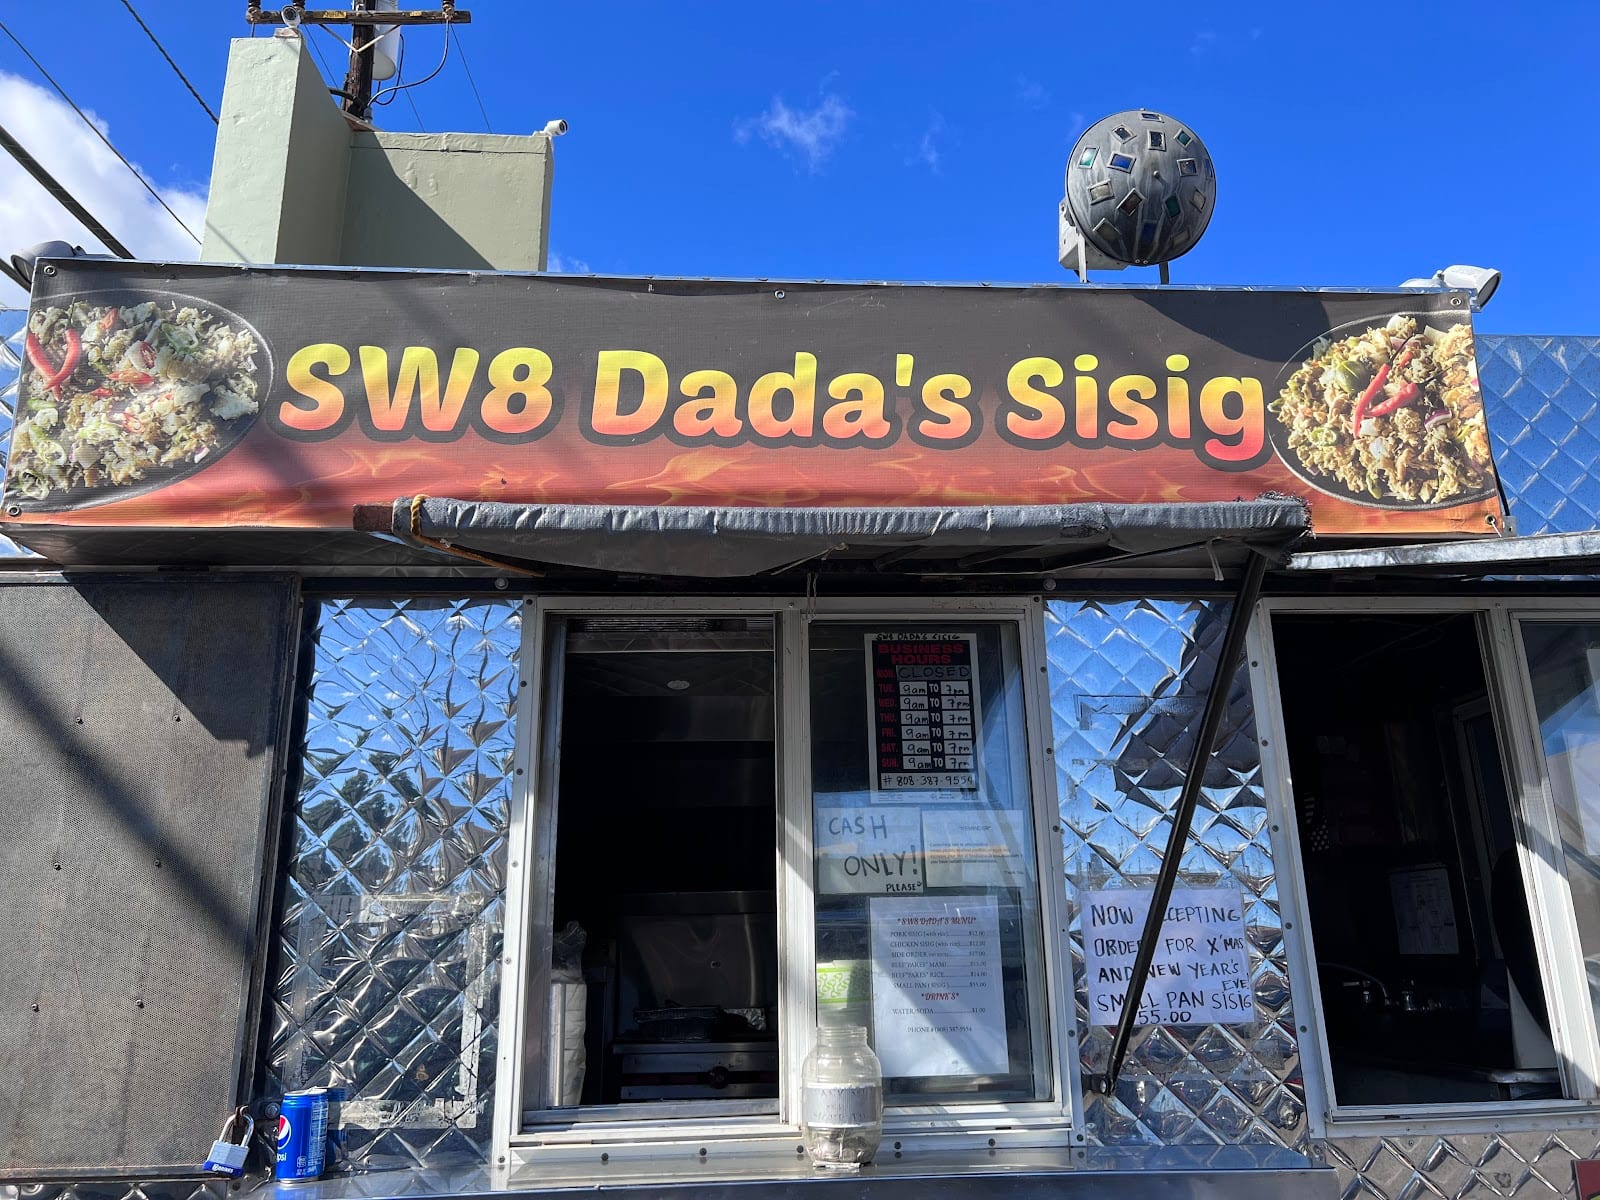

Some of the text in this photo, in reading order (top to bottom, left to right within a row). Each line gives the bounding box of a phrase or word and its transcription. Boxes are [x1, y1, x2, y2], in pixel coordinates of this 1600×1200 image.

[279, 343, 1265, 461] SW8 Dada's Sisig
[878, 644, 964, 654] BUSINESS
[891, 655, 952, 664] HOURS
[898, 667, 970, 679] CLOSED
[929, 683, 939, 692] TO
[930, 698, 940, 707] TO
[931, 713, 941, 722] TO
[932, 728, 942, 737] TO
[932, 743, 943, 752] TO
[933, 758, 943, 767] TO
[829, 815, 887, 839] CASH
[844, 844, 918, 876] ONLY!
[1091, 905, 1133, 927] NOW
[1165, 938, 1197, 955] FOR
[1207, 934, 1244, 956] X'MAS
[1187, 959, 1239, 979] YEAR'S
[1097, 992, 1160, 1012] SMLL
[1166, 991, 1205, 1009] PAN
